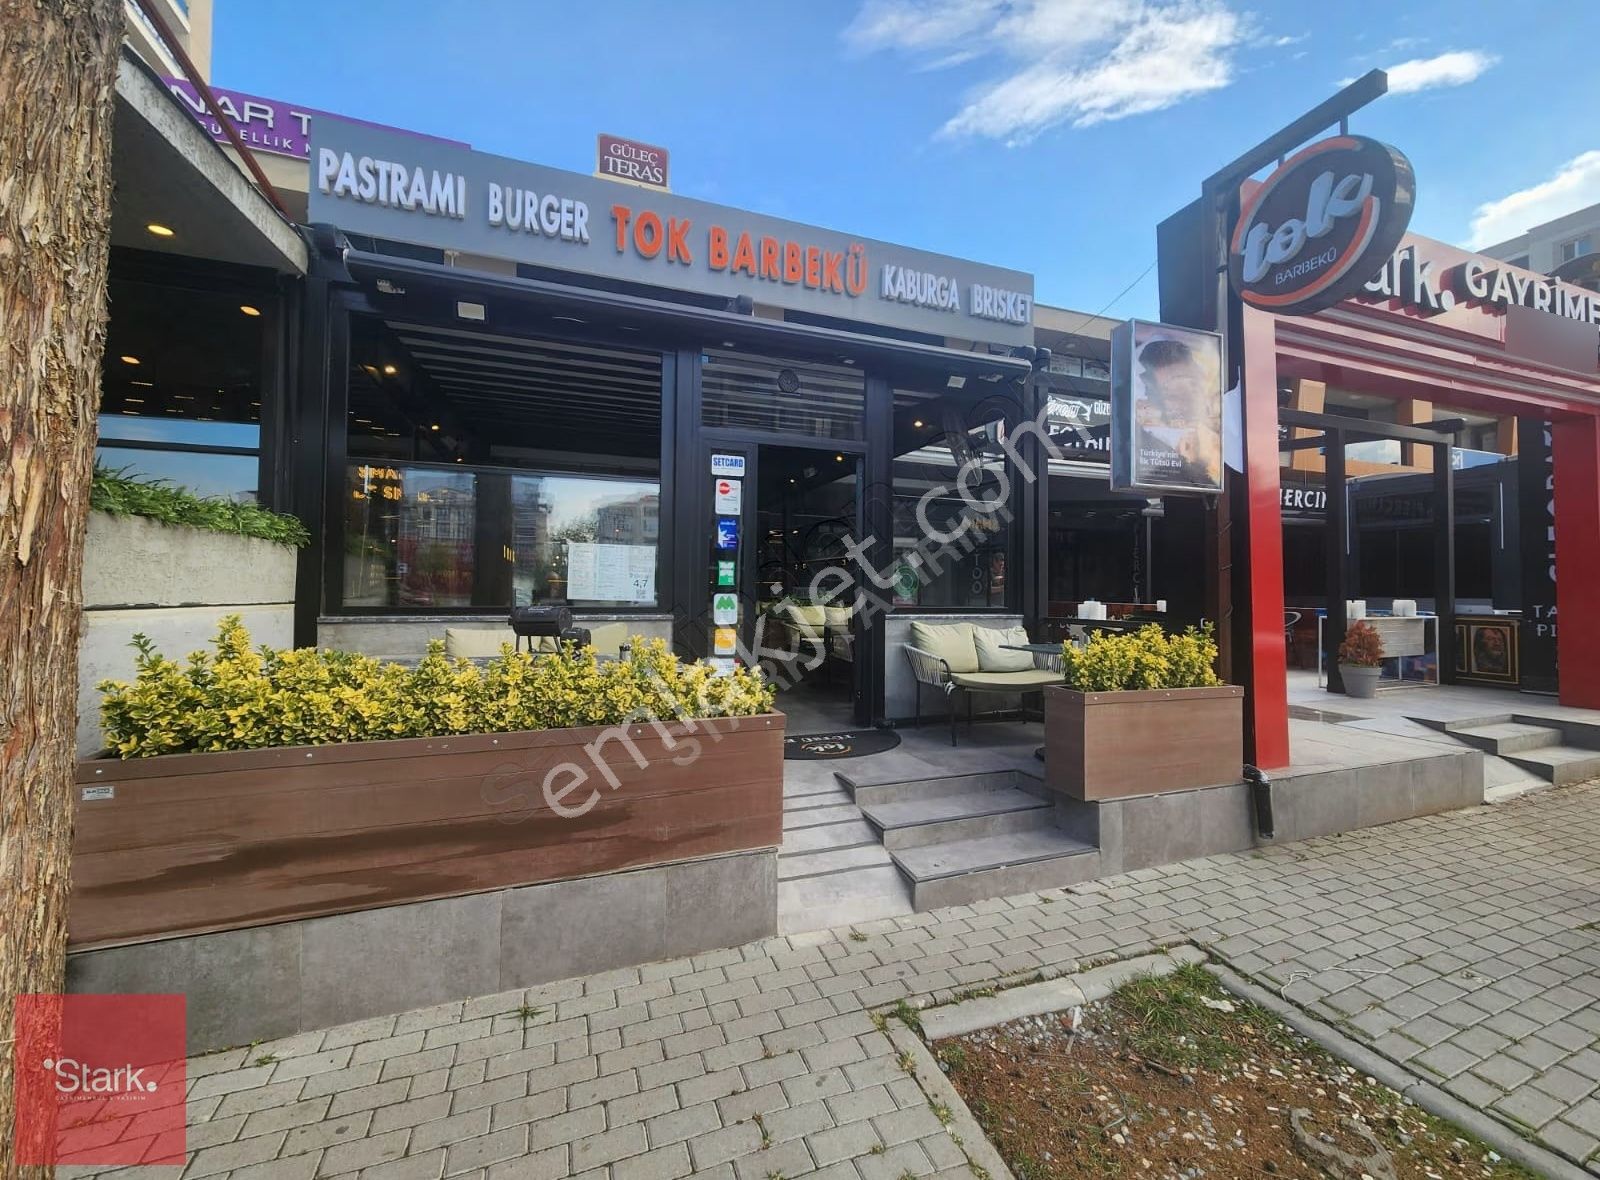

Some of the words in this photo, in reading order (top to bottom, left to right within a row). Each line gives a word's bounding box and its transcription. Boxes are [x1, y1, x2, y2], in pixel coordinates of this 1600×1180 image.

[604, 155, 663, 183] TERAS
[610, 143, 658, 167] GÜLEÇ
[318, 147, 467, 219] PASTRAMI
[487, 182, 591, 244] BURGER
[611, 203, 693, 265] TOK
[709, 224, 869, 298] BARBEKÜ
[880, 263, 960, 313] KABURGA
[968, 284, 1033, 325] BRISKET
[1240, 170, 1374, 284] tok
[1275, 246, 1338, 285] BARBEKÜ
[712, 457, 744, 469] SETCARD
